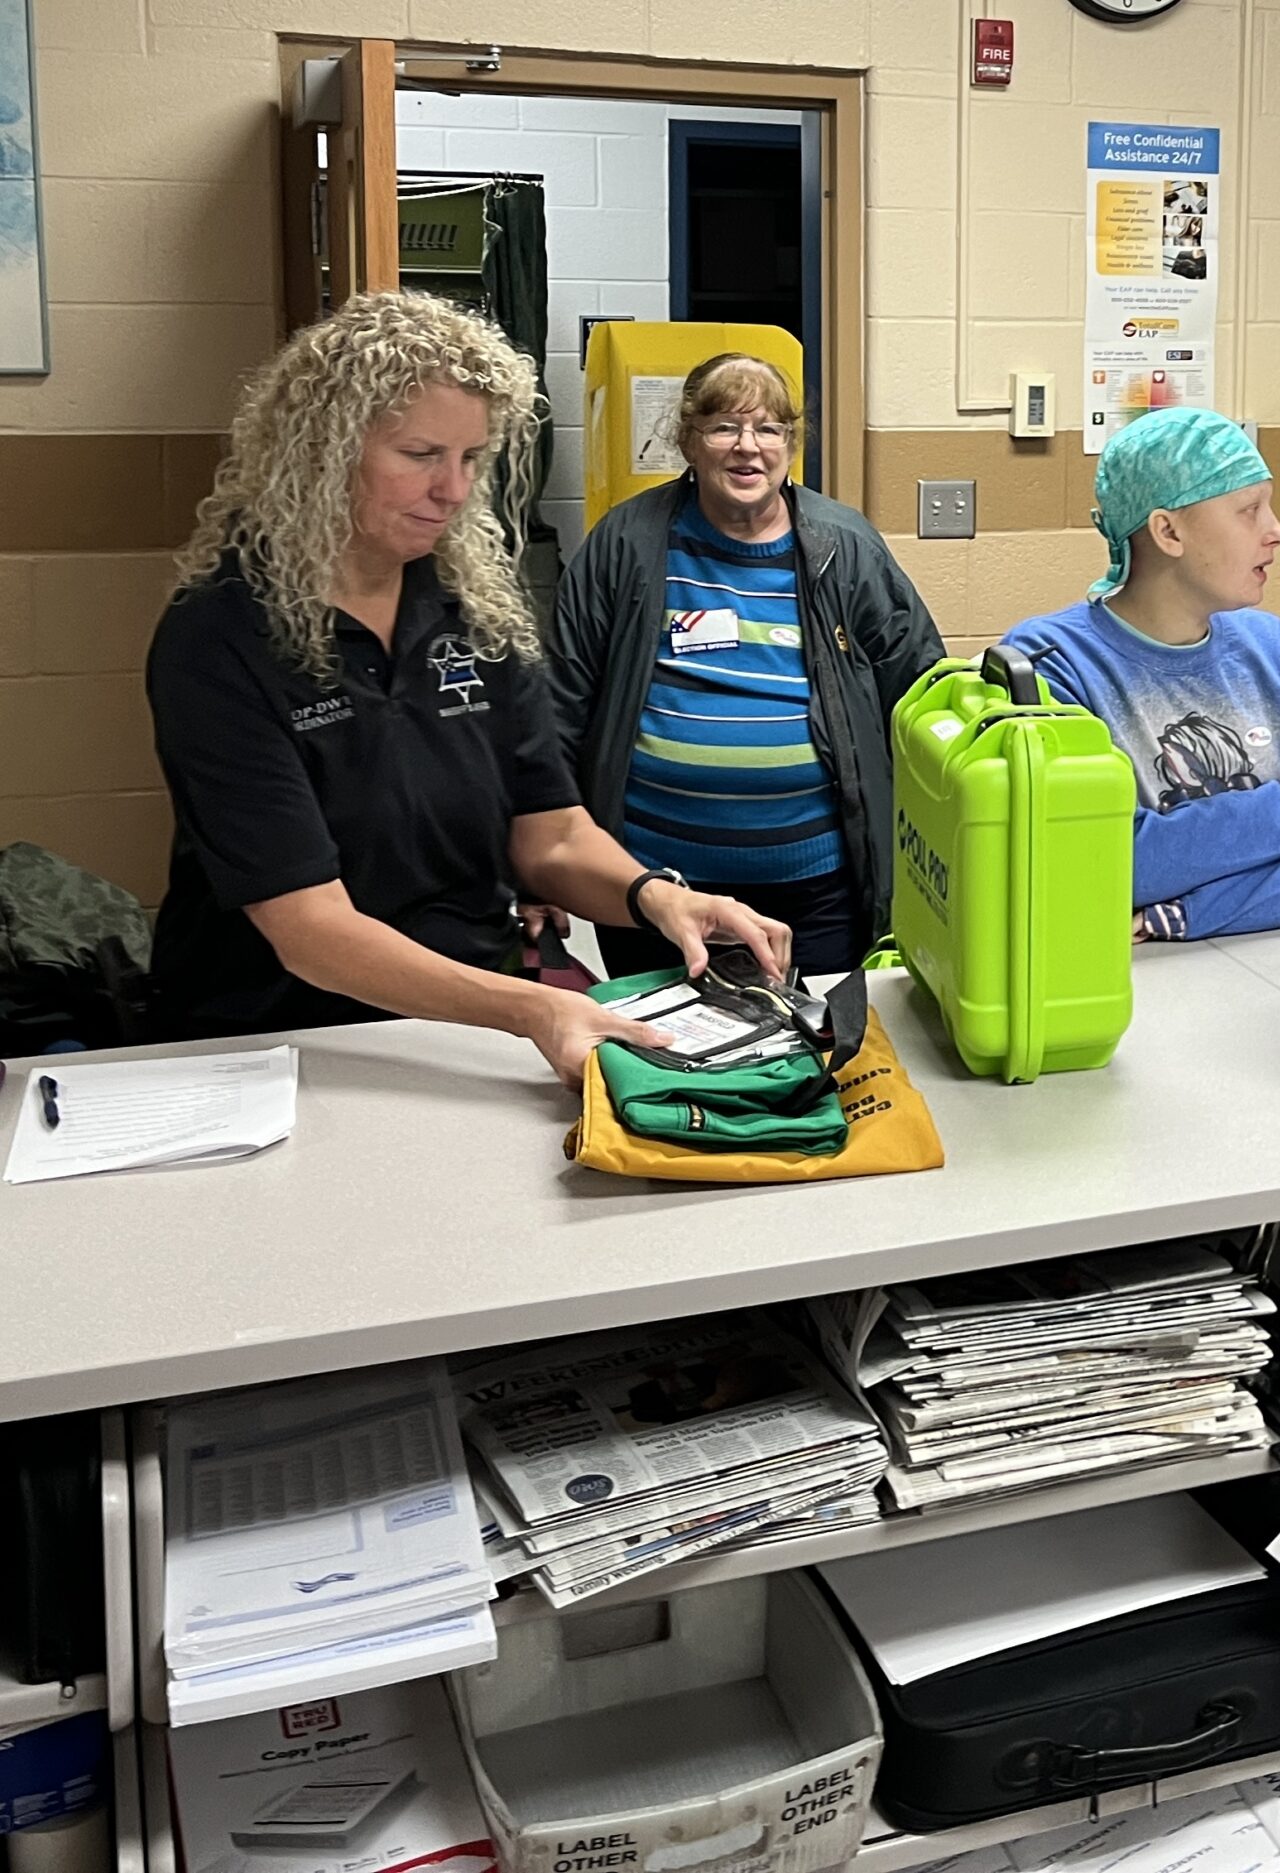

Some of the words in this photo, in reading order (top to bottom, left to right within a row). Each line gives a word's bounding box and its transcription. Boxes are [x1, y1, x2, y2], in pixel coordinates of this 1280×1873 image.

[982, 48, 1011, 60] FIRE
[1104, 132, 1131, 145] Free
[1133, 134, 1204, 149] Confidential
[1105, 149, 1169, 163] Assistance
[1172, 152, 1202, 165] 24/7
[1138, 330, 1159, 338] EAP
[707, 641, 739, 651] OFFICIAL
[291, 1706, 329, 1719] TRU
[293, 1715, 330, 1729] RED
[261, 1746, 311, 1761] Copy
[314, 1732, 371, 1751] Paper
[784, 1767, 855, 1804] LABEL
[780, 1784, 855, 1822] OTHER
[793, 1808, 838, 1836] END
[556, 1833, 637, 1855] LABEL
[553, 1850, 638, 1873] OTHER
